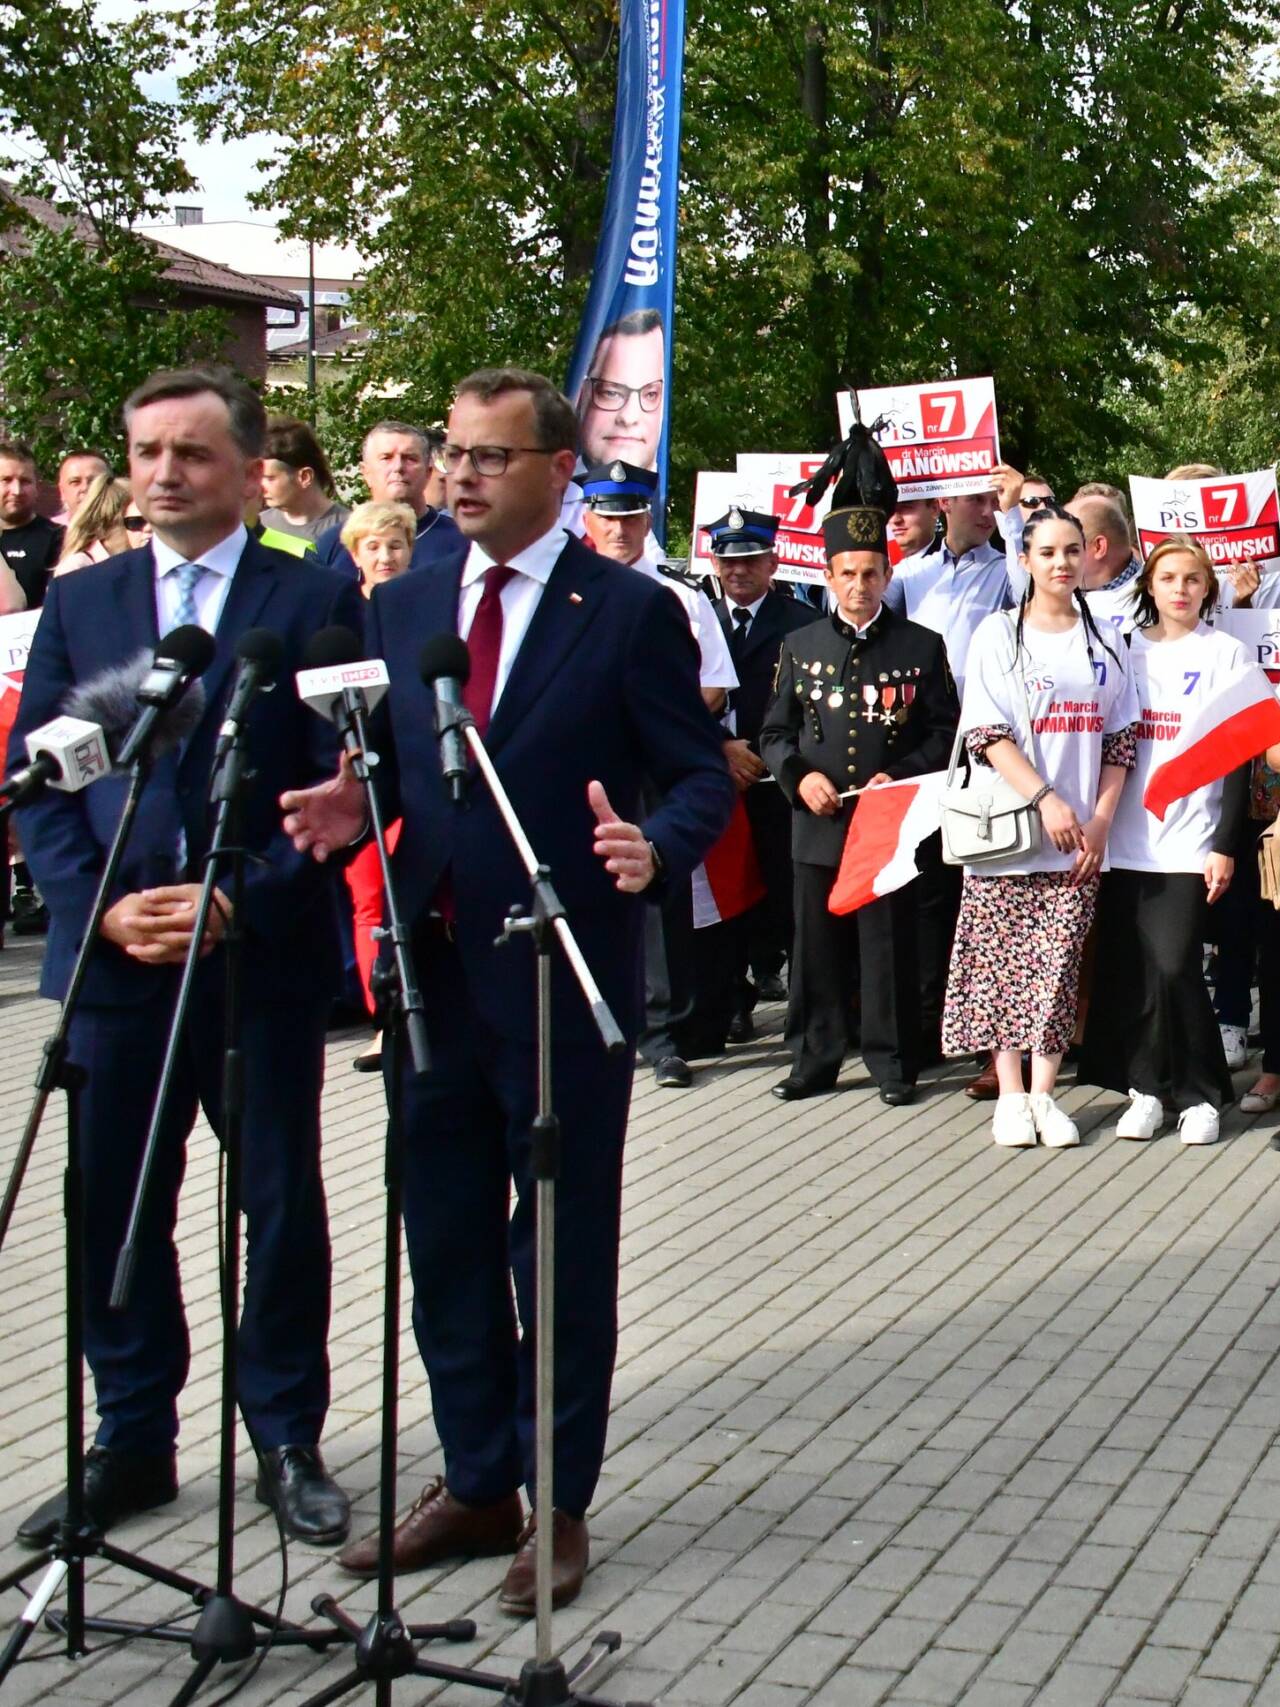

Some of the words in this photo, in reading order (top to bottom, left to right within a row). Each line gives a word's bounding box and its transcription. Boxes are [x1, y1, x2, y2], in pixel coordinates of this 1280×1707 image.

[930, 397, 957, 433] 7
[927, 424, 938, 433] nr
[915, 447, 946, 459] Marcin
[1211, 489, 1238, 522] 7
[1160, 511, 1198, 528] PiS
[1208, 515, 1219, 523] nr
[343, 667, 380, 683] INFO
[1183, 672, 1201, 695] 7
